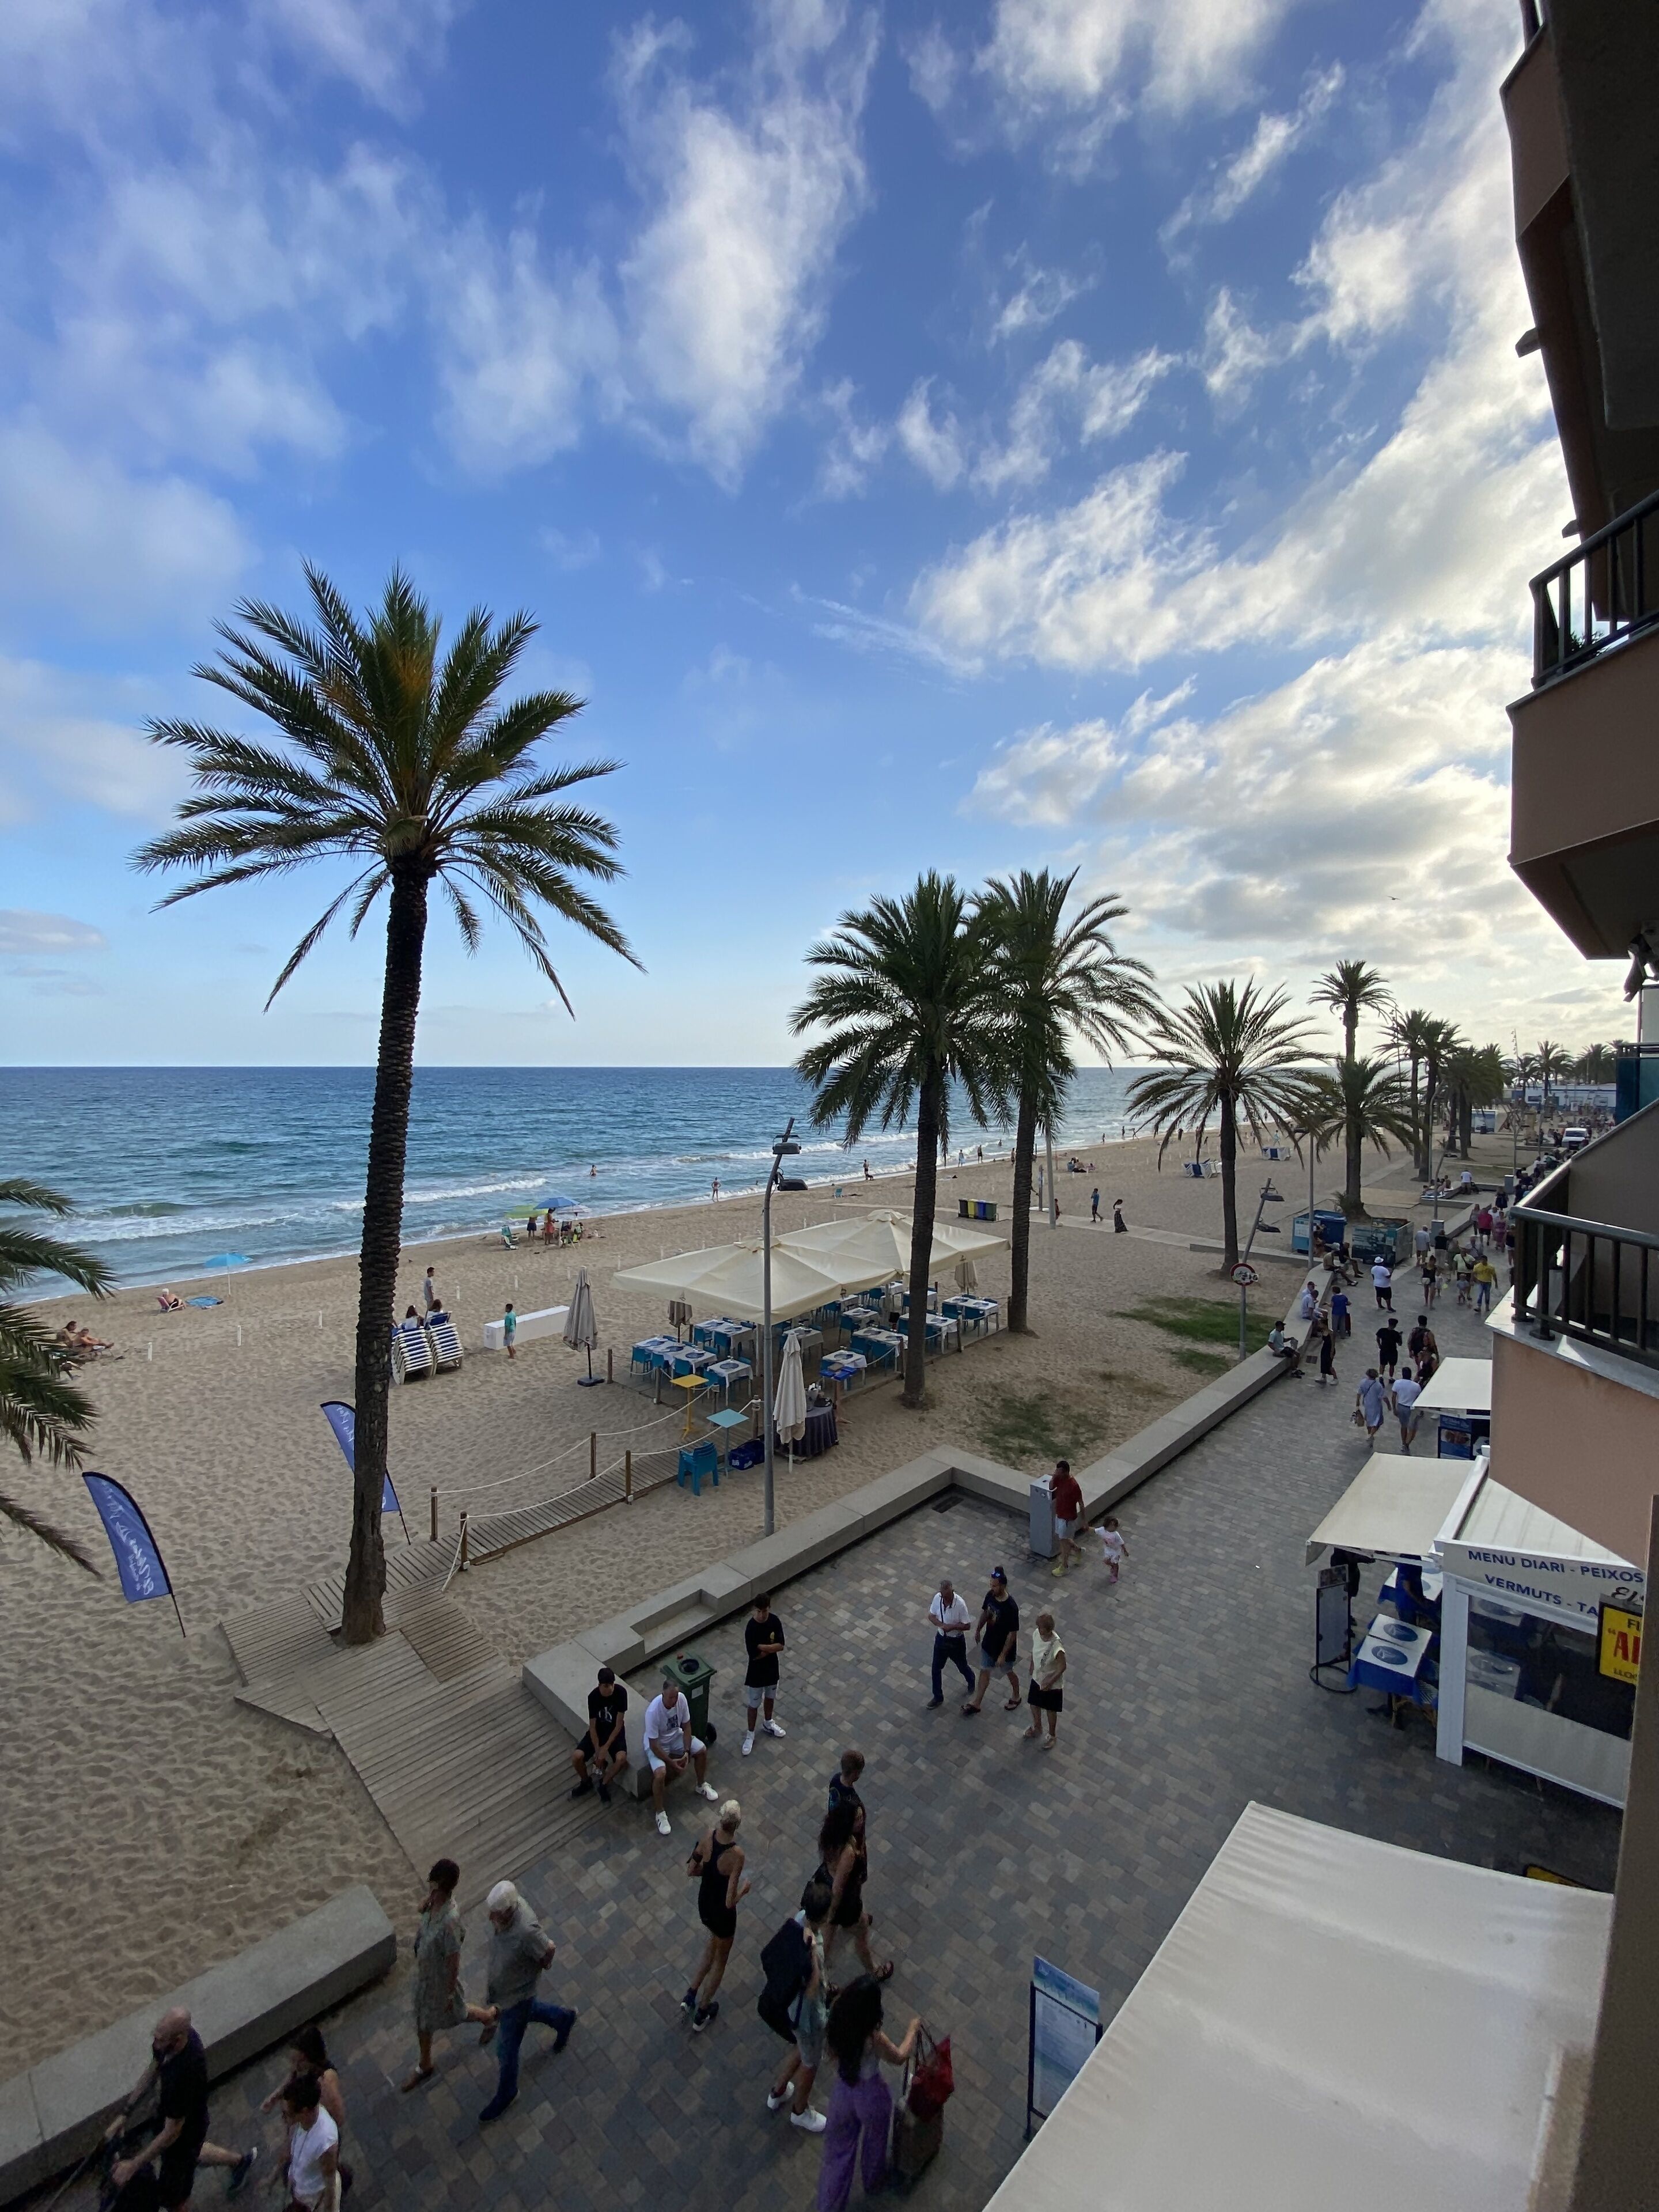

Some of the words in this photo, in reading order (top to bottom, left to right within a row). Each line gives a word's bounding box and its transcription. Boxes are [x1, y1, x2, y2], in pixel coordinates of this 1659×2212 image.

[1468, 1550, 1516, 1566] MENU
[1521, 1558, 1565, 1573] DIARI
[1580, 1566, 1644, 1583] PEIXOS
[1484, 1574, 1562, 1605] VERMUTS
